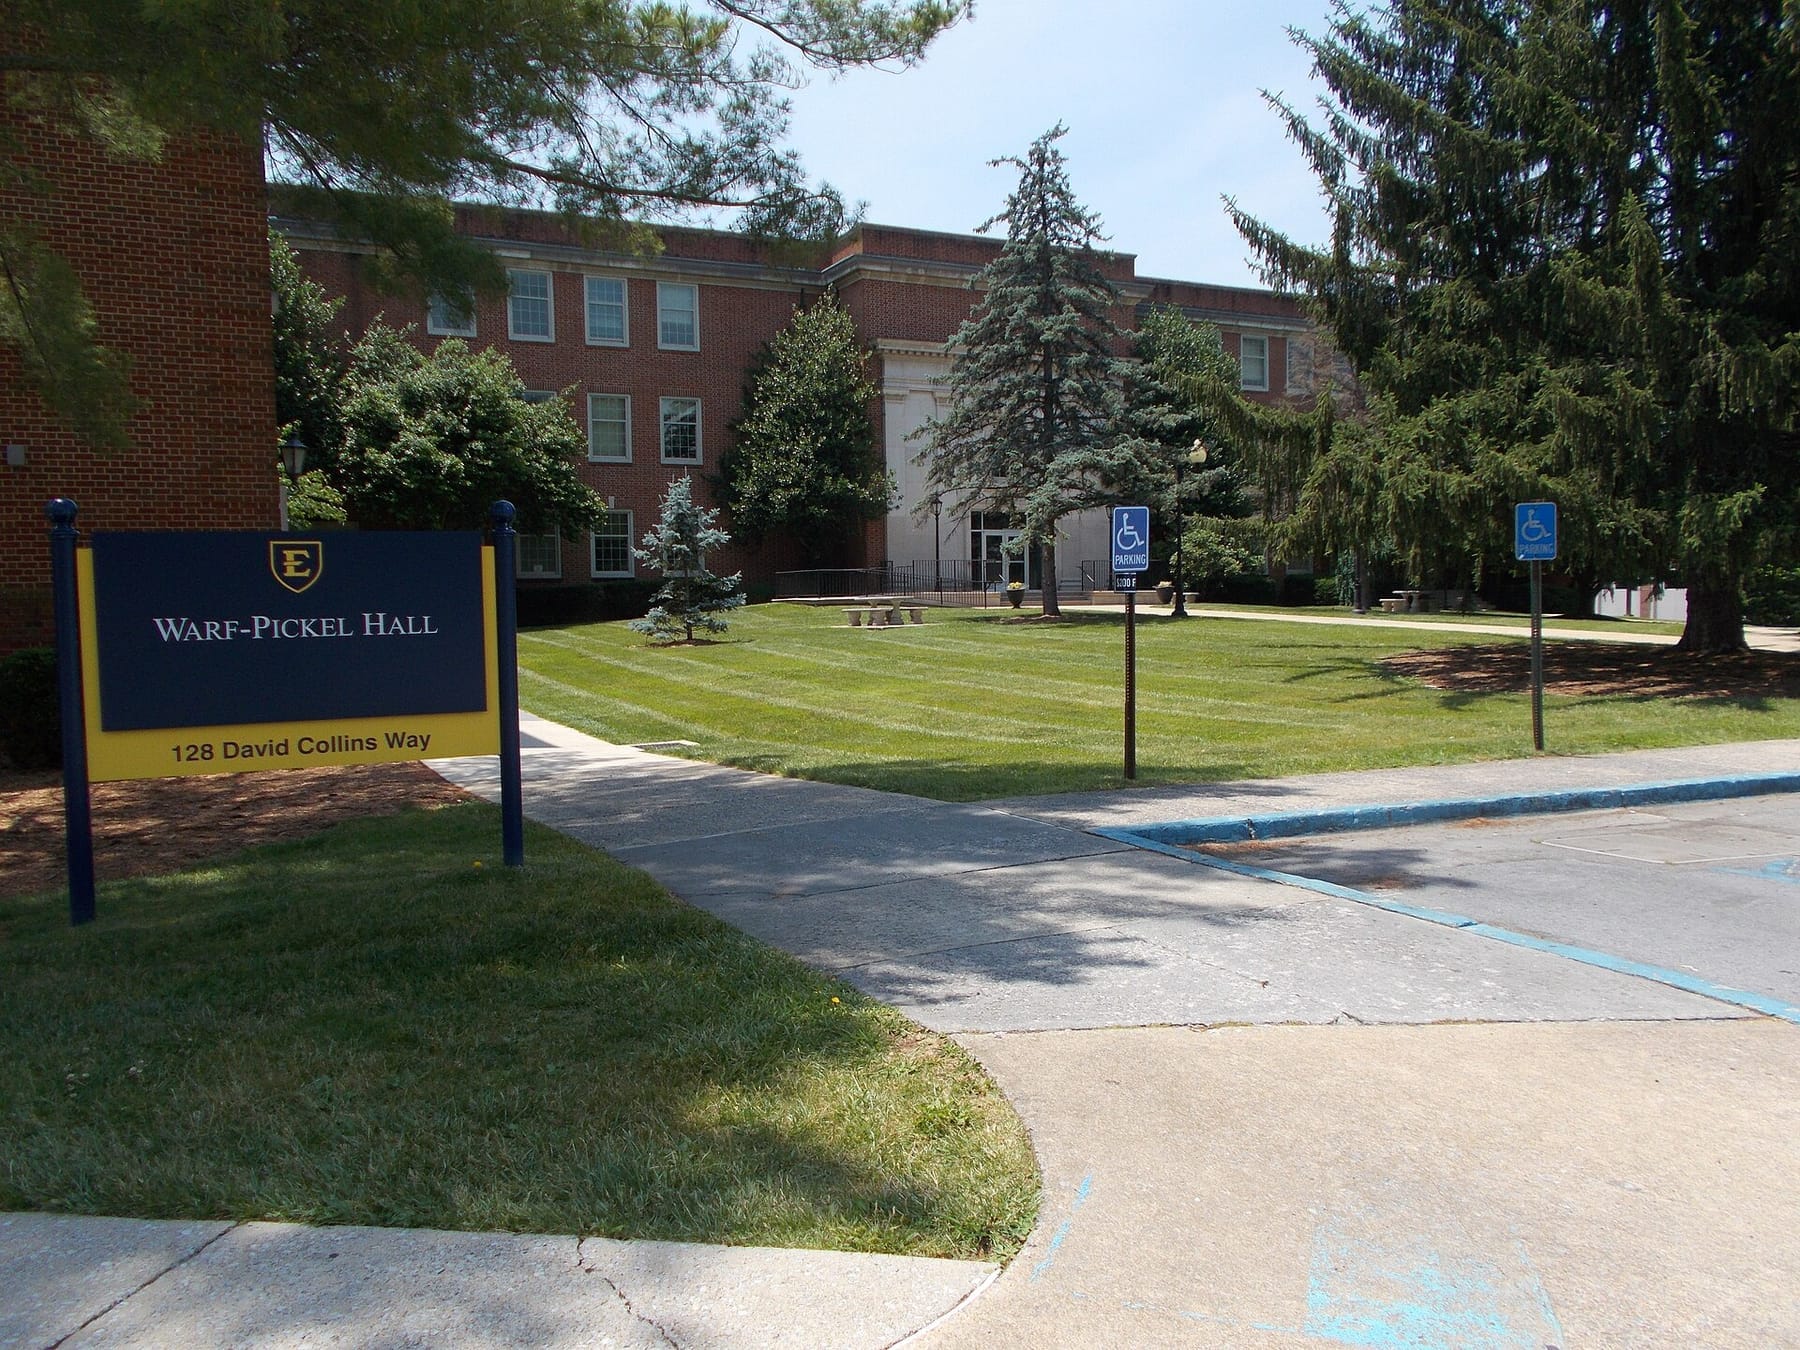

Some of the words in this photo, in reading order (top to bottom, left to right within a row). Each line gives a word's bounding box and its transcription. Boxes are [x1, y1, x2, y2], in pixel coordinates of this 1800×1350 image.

[282, 549, 311, 578] E
[1115, 554, 1146, 565] PARKING
[153, 615, 354, 643] WARF-PICKEL
[362, 612, 439, 637] HALL
[172, 743, 215, 762] 128
[222, 739, 290, 760] David
[297, 735, 378, 755] Collins
[384, 731, 432, 751] Way
